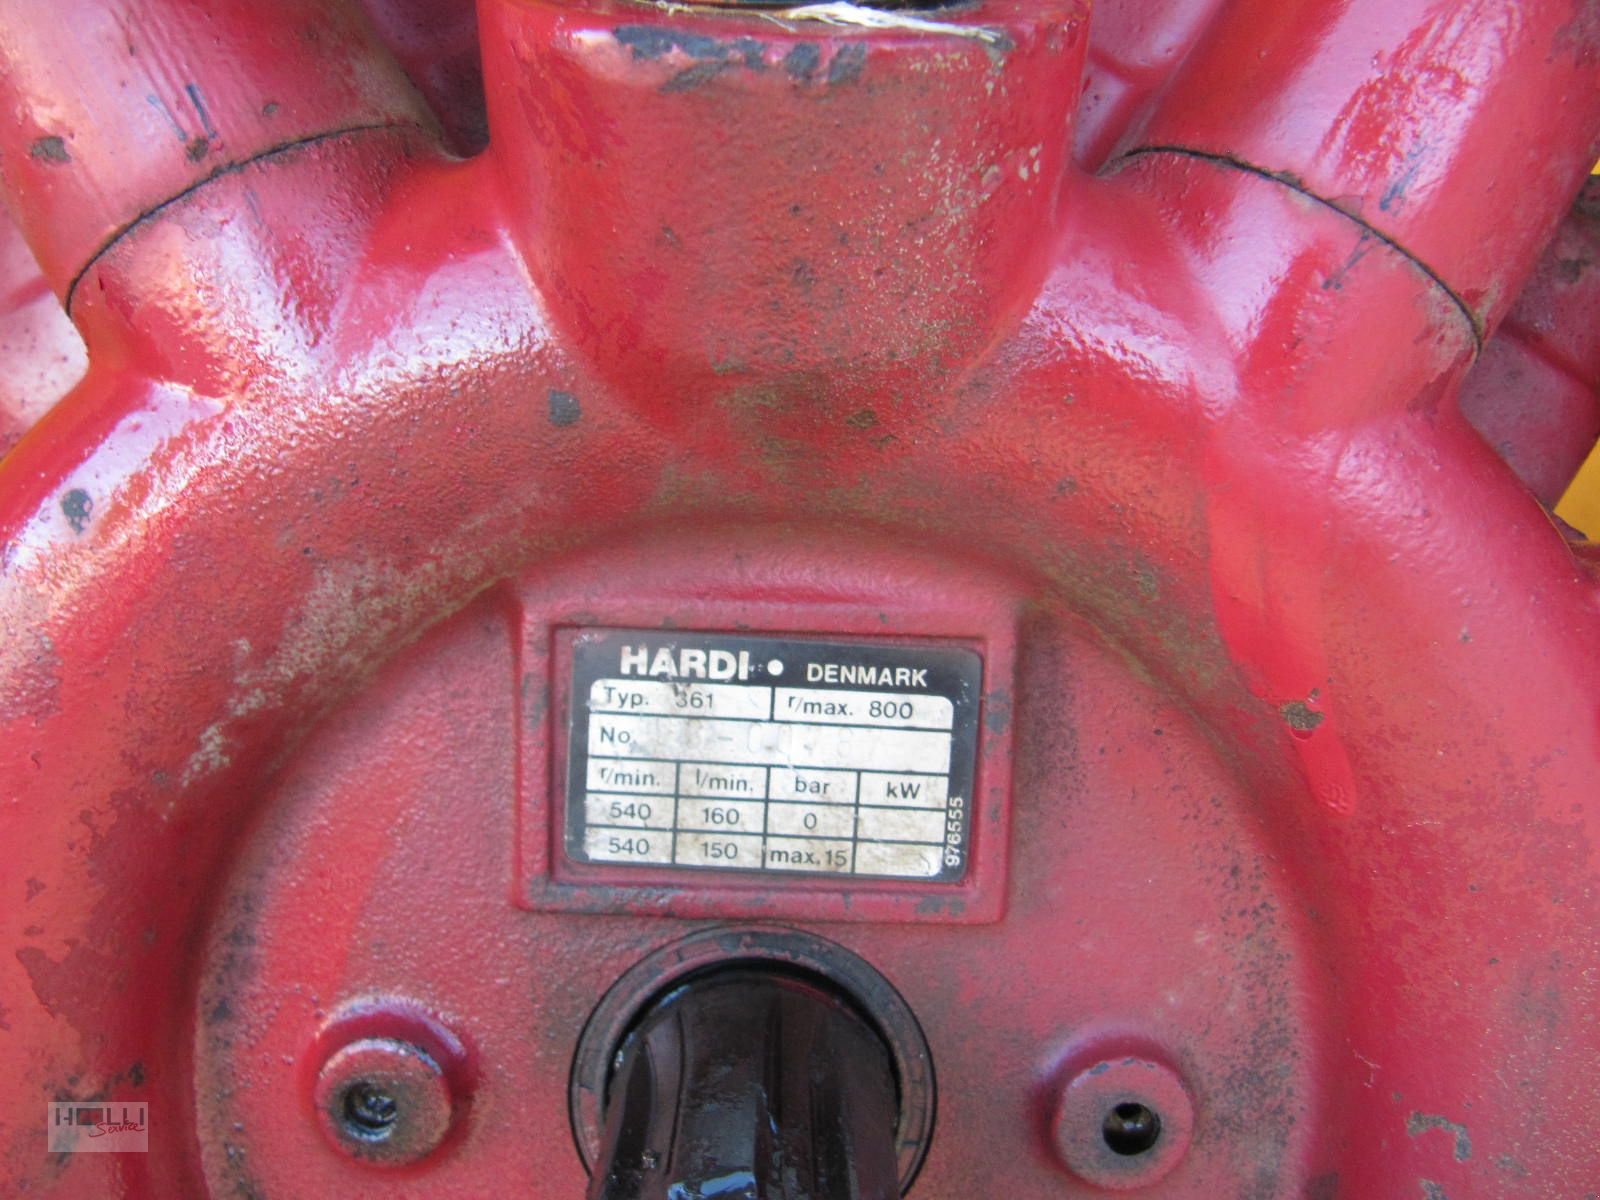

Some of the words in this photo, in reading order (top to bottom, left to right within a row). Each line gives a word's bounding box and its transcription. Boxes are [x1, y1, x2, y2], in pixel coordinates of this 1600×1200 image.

[620, 645, 750, 680] HARDI
[807, 663, 928, 687] DENMARK
[604, 686, 649, 707] Typ.
[675, 691, 714, 709] 361
[788, 695, 853, 716] r/max.
[869, 700, 913, 719] 800
[600, 767, 660, 787] r/min.
[795, 776, 831, 794] bar
[887, 781, 921, 799] kW
[609, 801, 651, 820] 540
[703, 807, 740, 825] 160
[803, 812, 817, 830] 0
[945, 796, 964, 867] 976555
[608, 837, 650, 855] 540
[701, 842, 738, 860] 150
